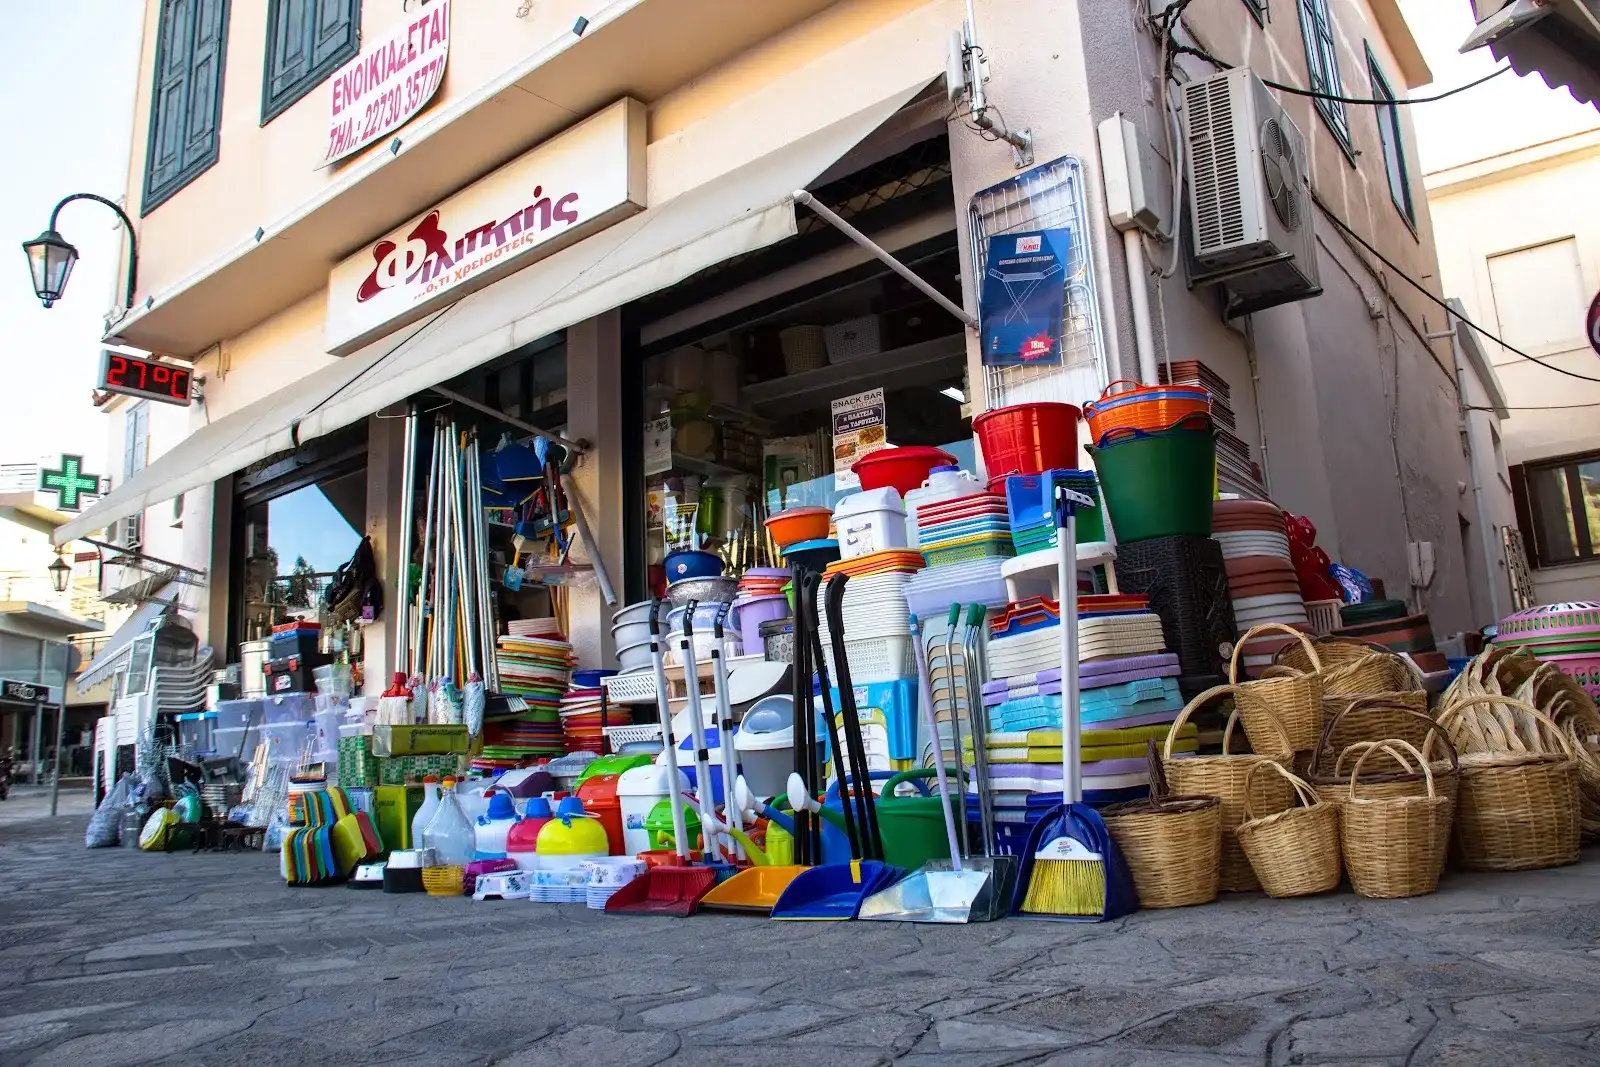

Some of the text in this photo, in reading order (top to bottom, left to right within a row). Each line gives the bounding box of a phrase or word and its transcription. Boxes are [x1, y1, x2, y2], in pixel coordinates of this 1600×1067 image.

[361, 83, 402, 142] 22730
[404, 54, 444, 115] 35770
[453, 231, 536, 284] χρειαστείς
[832, 391, 883, 409] SNACK BAR
